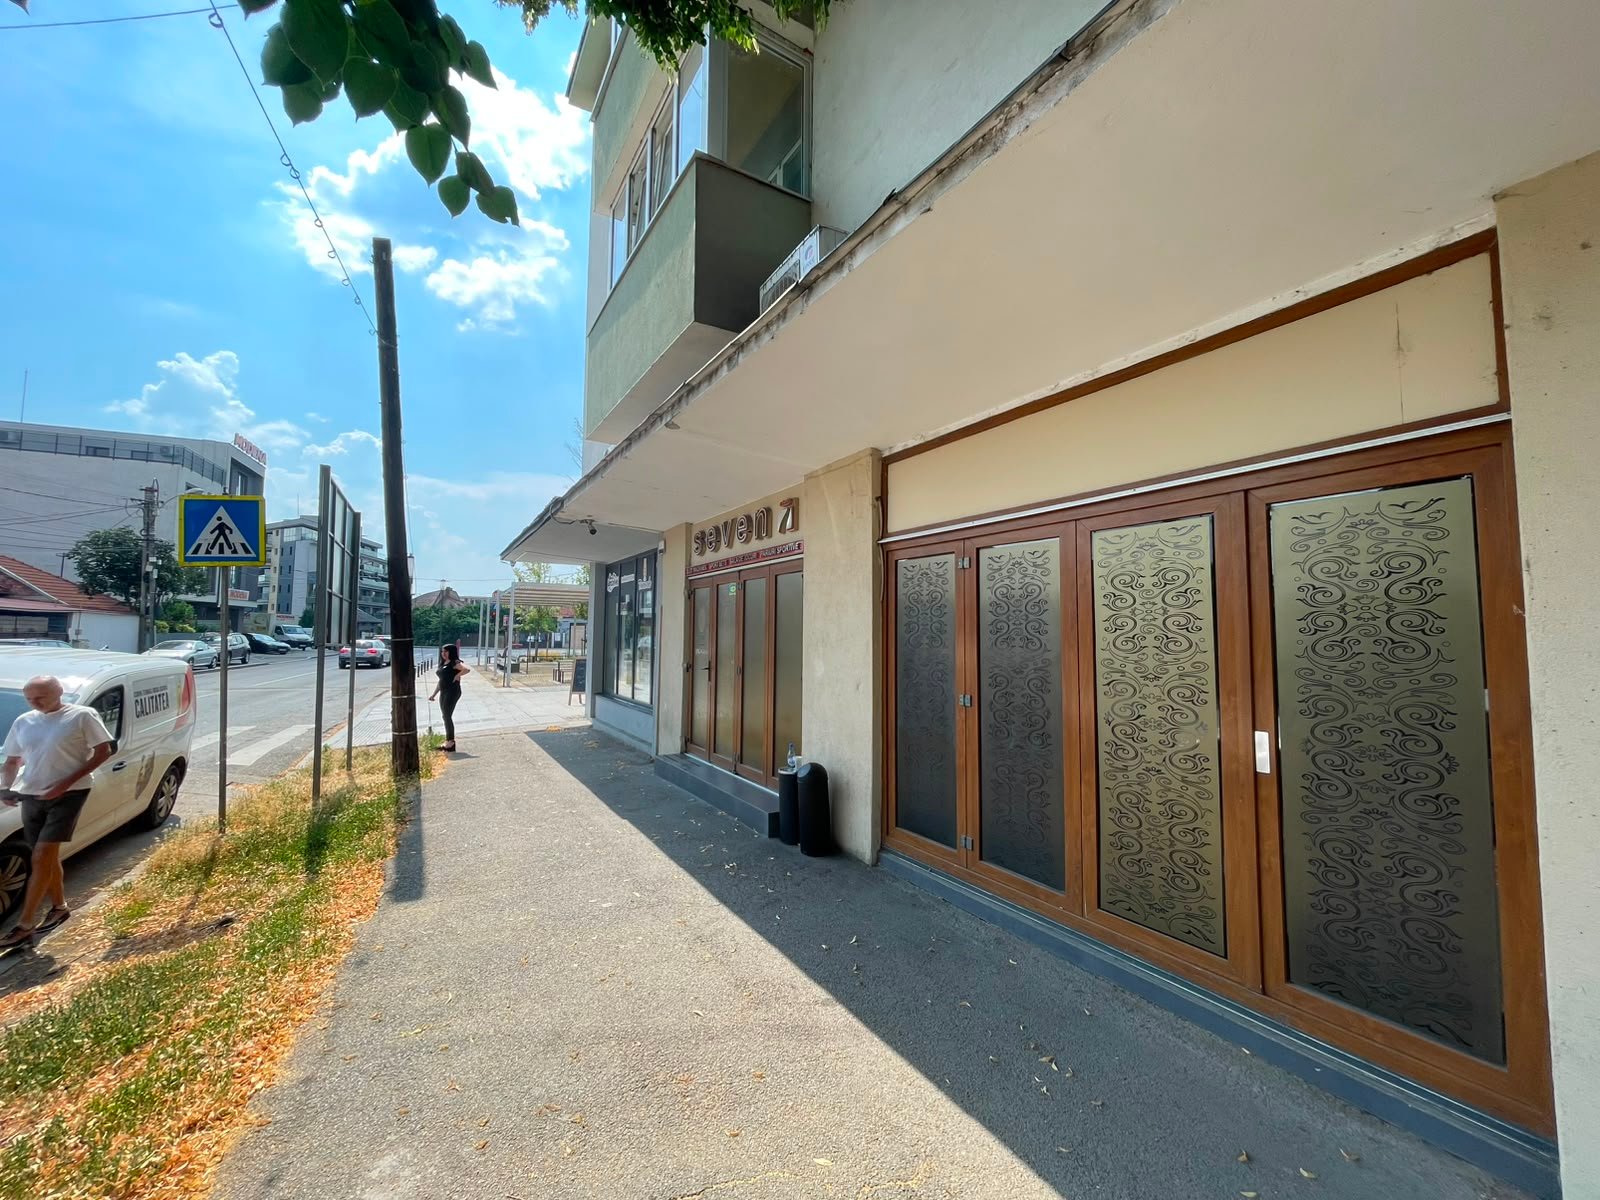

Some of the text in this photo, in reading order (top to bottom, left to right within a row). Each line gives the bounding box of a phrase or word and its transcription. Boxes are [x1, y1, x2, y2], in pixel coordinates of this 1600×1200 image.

[693, 497, 800, 557] seven 7
[776, 541, 800, 554] SPORTIVE
[134, 691, 170, 719] CALITATEA
